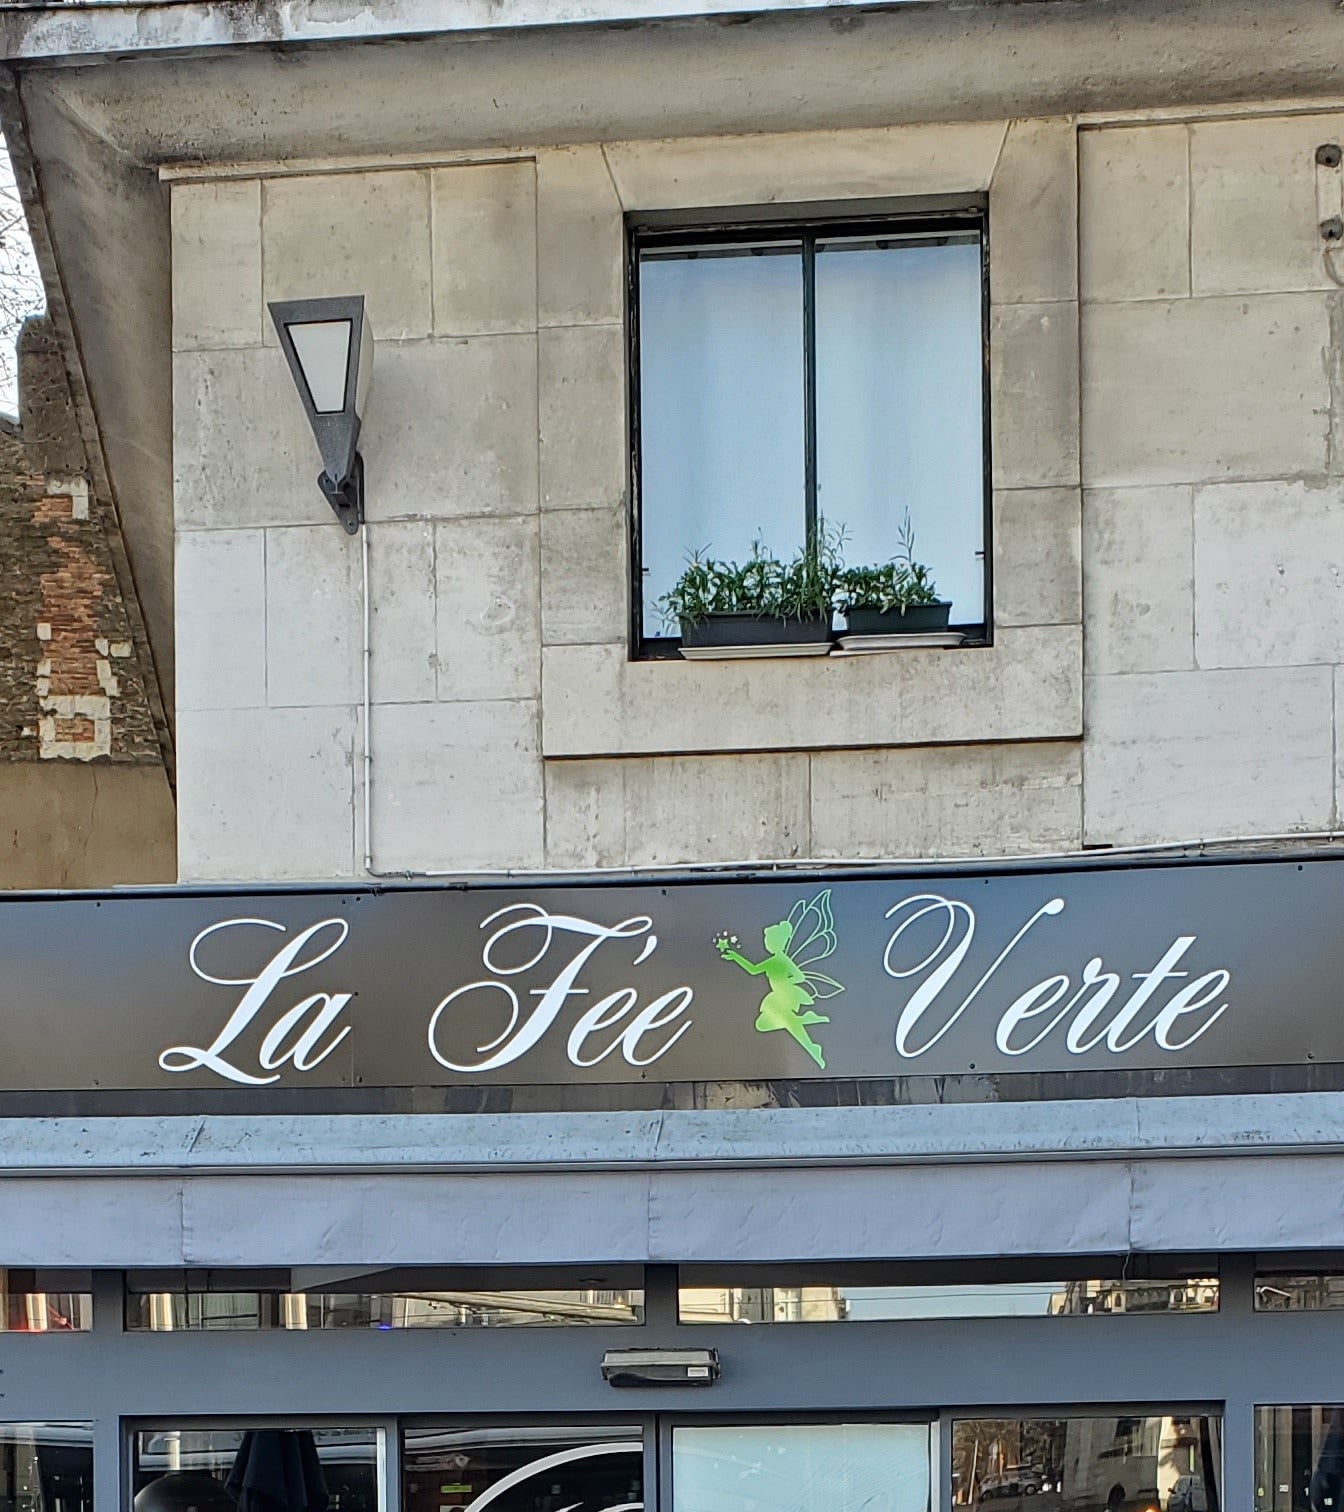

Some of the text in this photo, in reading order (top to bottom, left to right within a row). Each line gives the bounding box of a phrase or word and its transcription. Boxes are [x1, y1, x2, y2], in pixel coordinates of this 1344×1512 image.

[158, 893, 1231, 1086] La Fée Verte
